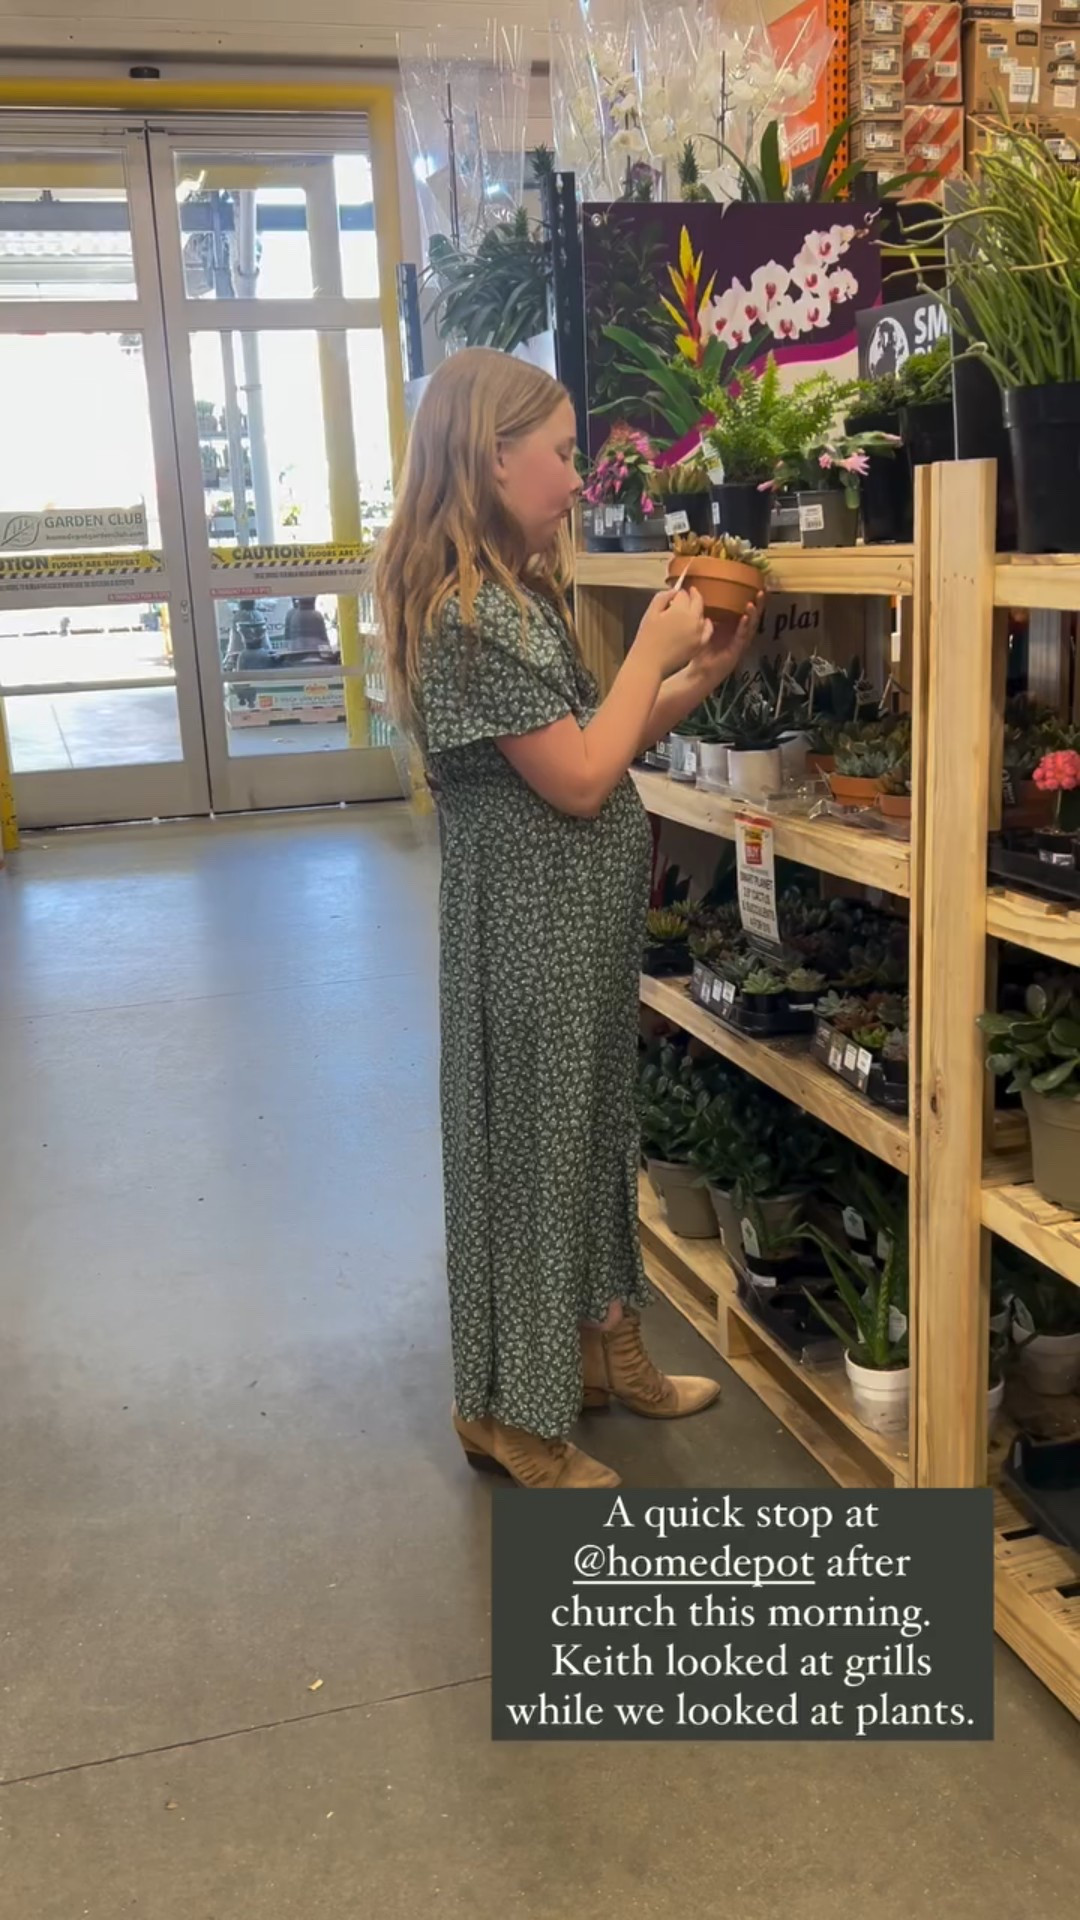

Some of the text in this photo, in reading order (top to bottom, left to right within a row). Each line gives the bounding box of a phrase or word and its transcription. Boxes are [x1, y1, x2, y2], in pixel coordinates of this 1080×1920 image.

[44, 513, 142, 529] GARDEN CLUB
[232, 545, 305, 560] CAUTION
[0, 554, 49, 571] TION
